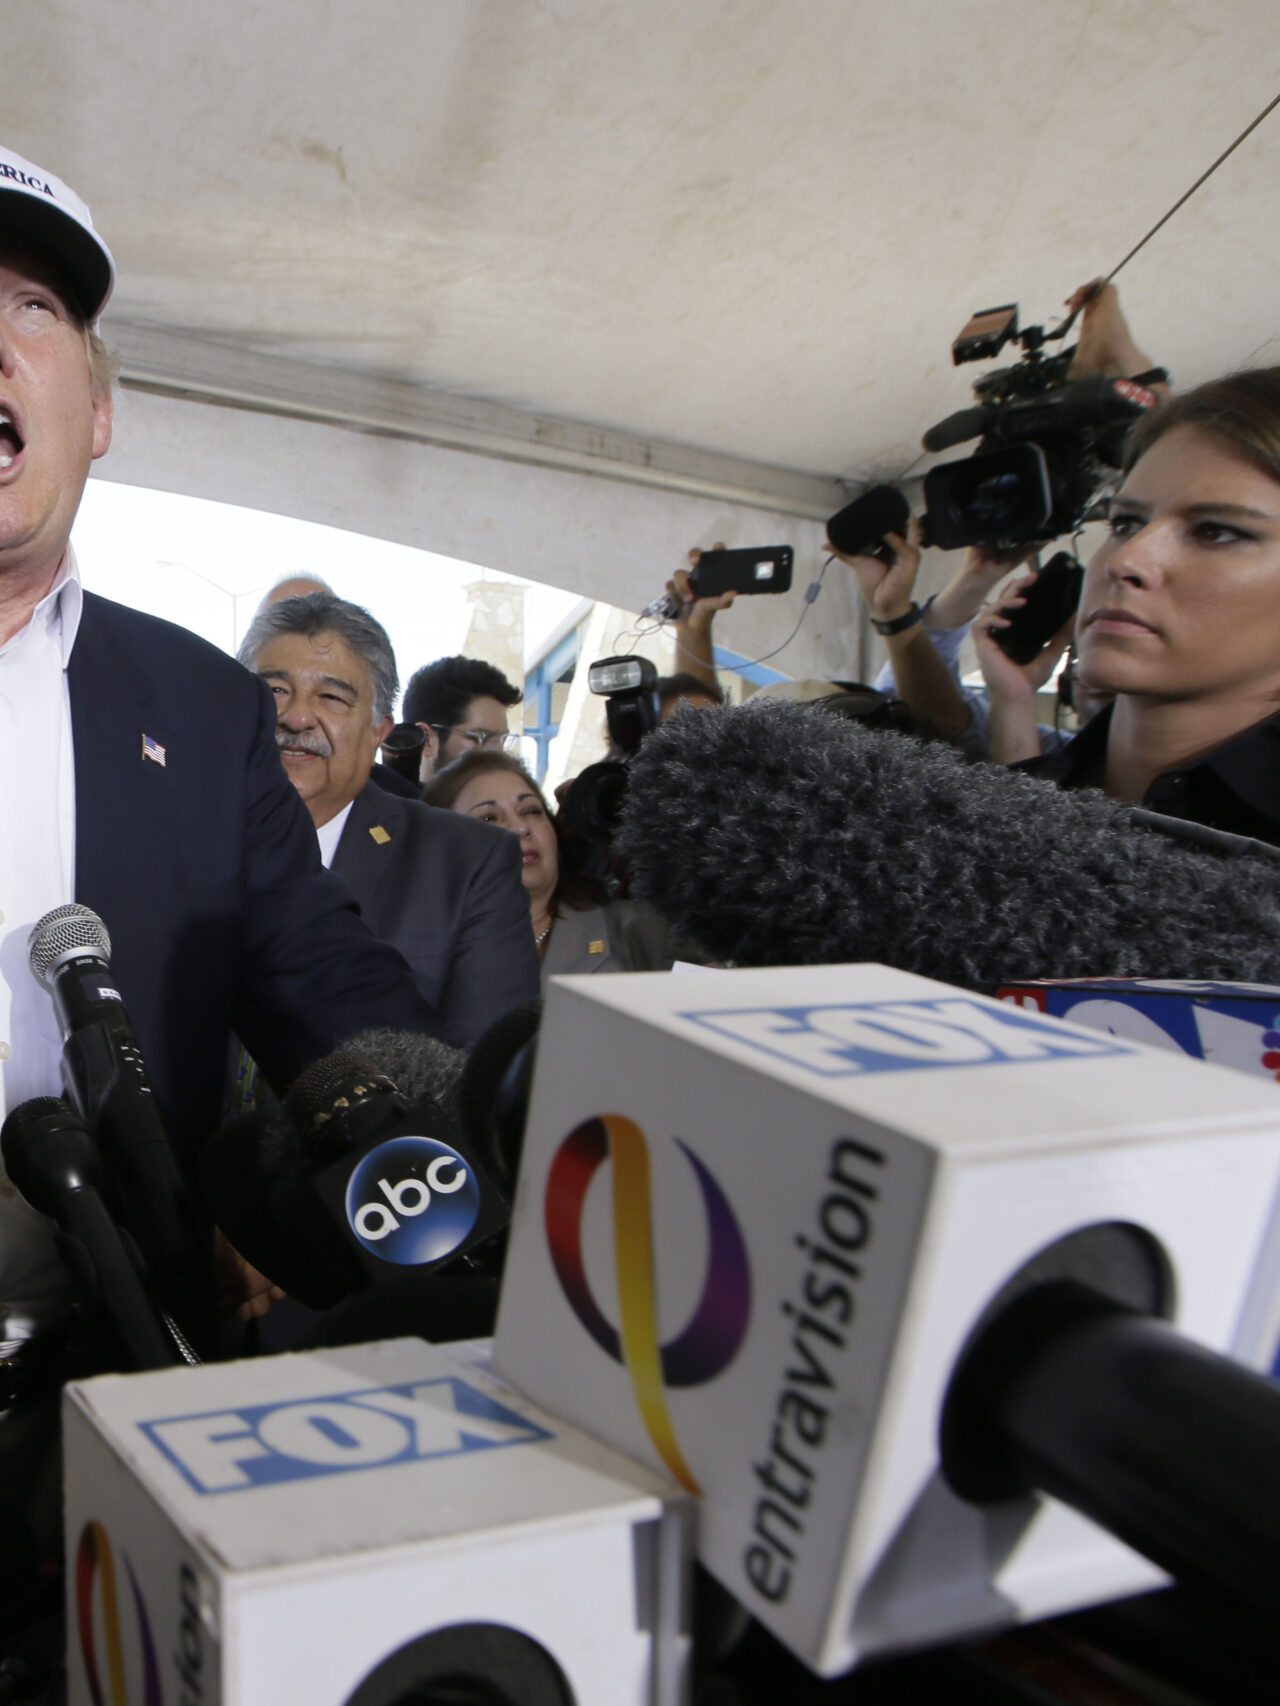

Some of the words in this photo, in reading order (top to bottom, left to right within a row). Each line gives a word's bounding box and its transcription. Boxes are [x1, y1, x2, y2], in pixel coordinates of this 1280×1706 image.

[692, 1000, 1112, 1073] FOX
[353, 1155, 468, 1241] abc
[742, 1135, 888, 1606] entravision
[152, 1381, 541, 1489] FOX
